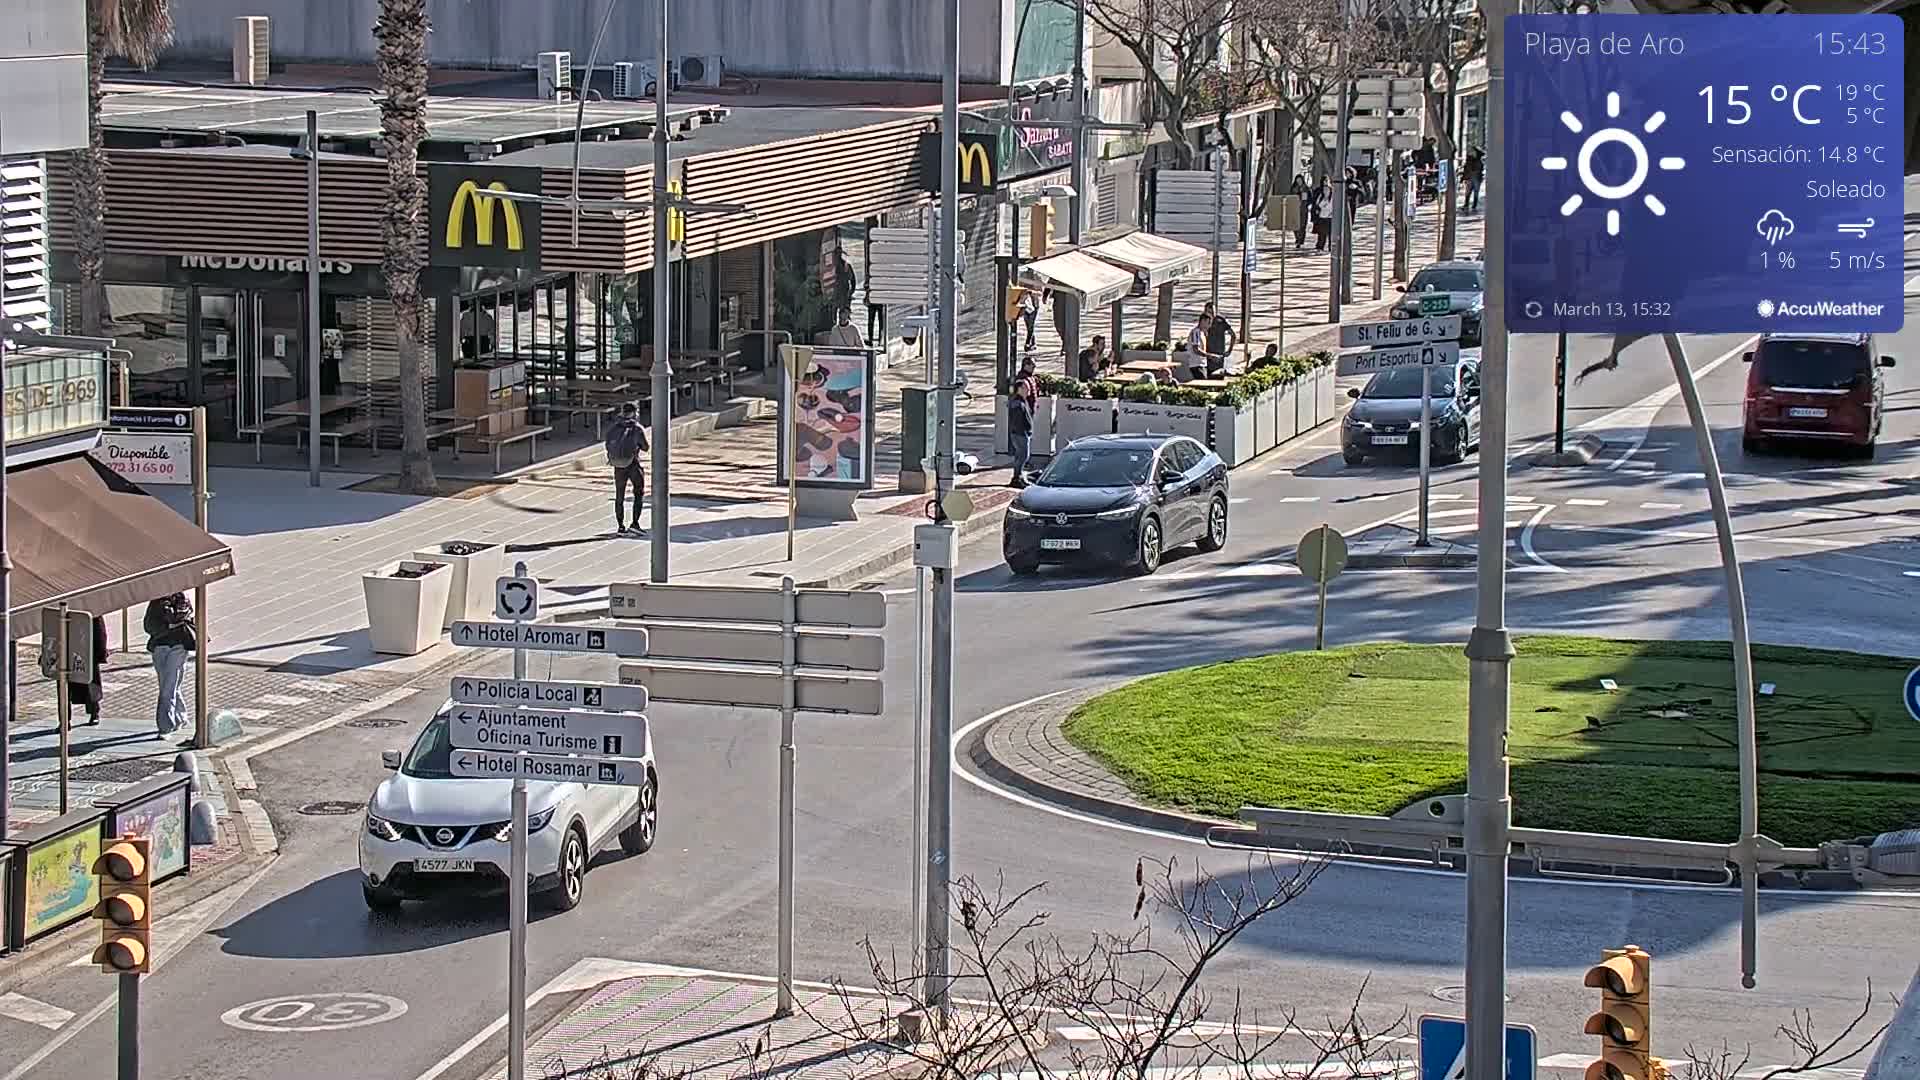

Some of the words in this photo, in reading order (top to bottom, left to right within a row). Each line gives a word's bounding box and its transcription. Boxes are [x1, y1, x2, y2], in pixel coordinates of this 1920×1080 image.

[1358, 326, 1372, 341] St.
[1376, 324, 1401, 337] Feliu
[1405, 323, 1418, 336] de
[1422, 321, 1433, 336] G.
[1355, 355, 1376, 369] Port
[1380, 351, 1418, 368] Esportiu
[32, 385, 54, 408] DE
[108, 445, 171, 461] Disponible
[128, 462, 140, 473] 31
[142, 462, 158, 474] 65
[159, 463, 174, 474] 00
[477, 625, 519, 643] Hotel
[523, 627, 581, 646] Aromar
[477, 681, 530, 700] Policia
[535, 684, 578, 702] Local
[477, 709, 567, 730] Ajuntament
[477, 728, 531, 746] Oficina
[536, 732, 598, 750] Turisme
[477, 755, 518, 773] Hotel
[523, 758, 593, 777] Rosamar
[421, 860, 448, 870] 4577
[451, 860, 473, 870] JKN
